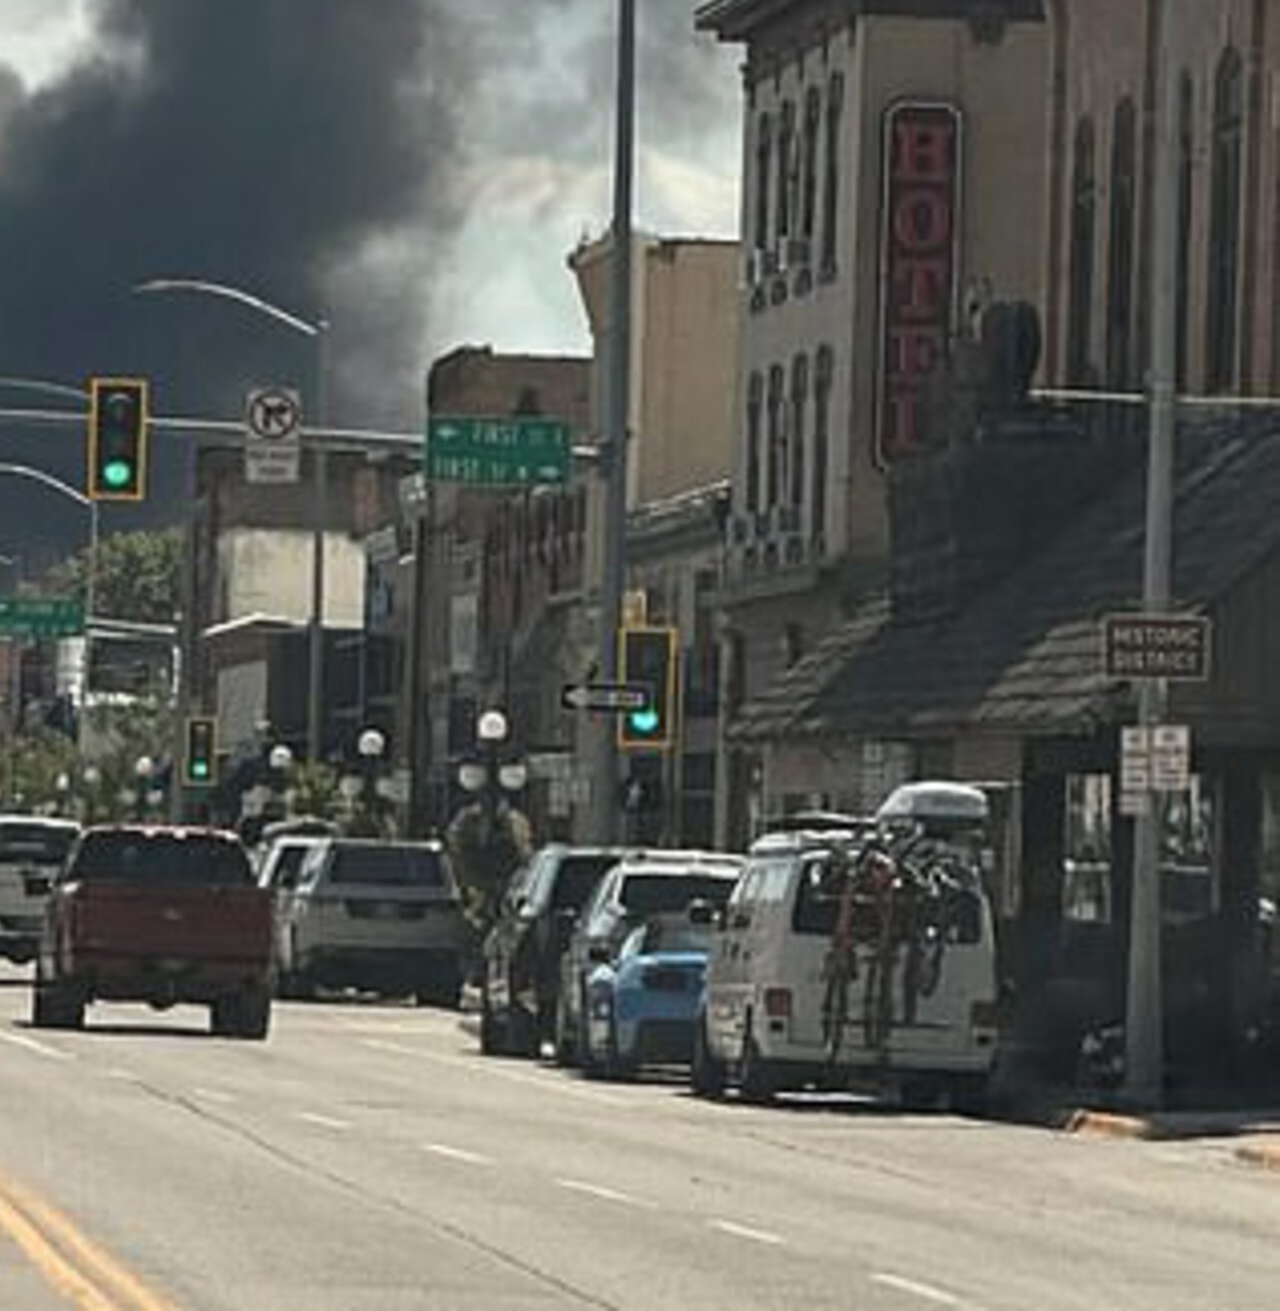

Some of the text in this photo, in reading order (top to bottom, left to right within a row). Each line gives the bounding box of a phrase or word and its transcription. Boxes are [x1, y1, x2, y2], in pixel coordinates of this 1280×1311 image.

[887, 118, 954, 450] HOTEL
[471, 422, 520, 446] FIRST
[434, 455, 480, 481] FIRST
